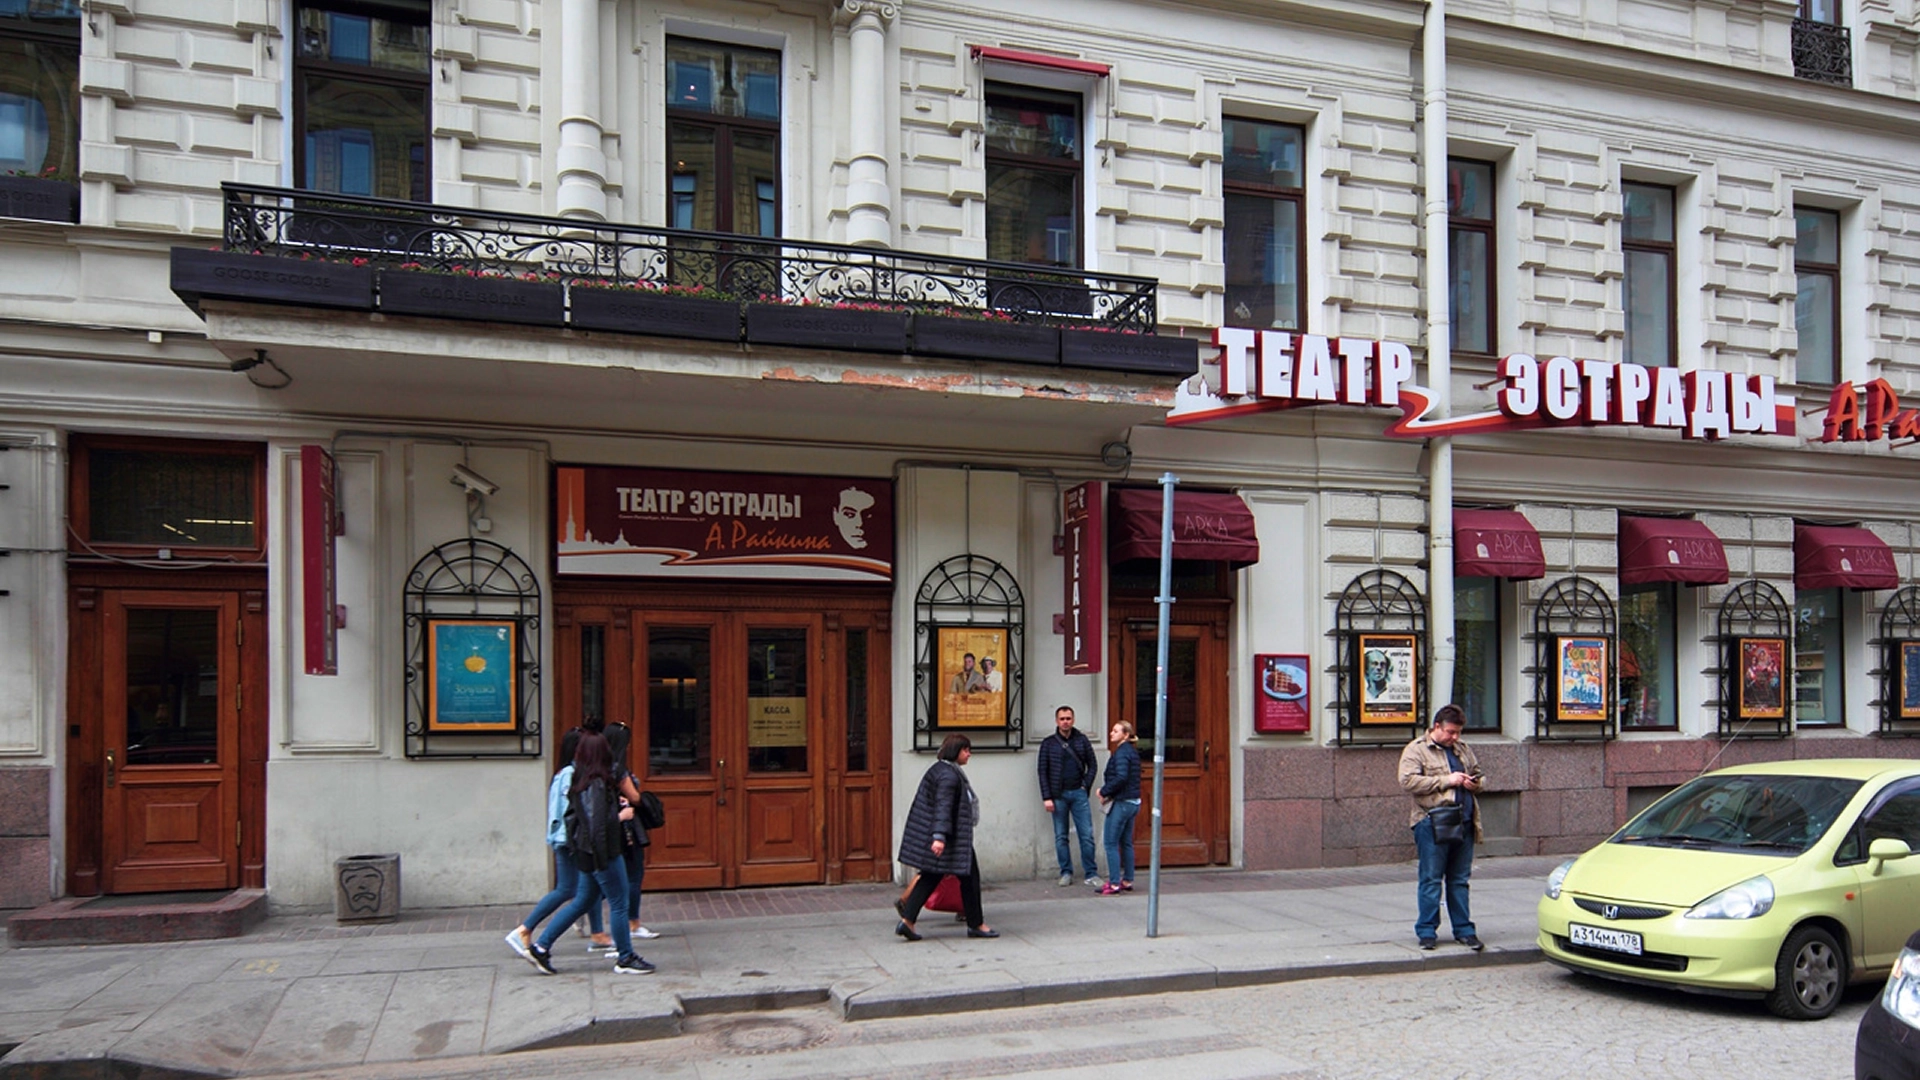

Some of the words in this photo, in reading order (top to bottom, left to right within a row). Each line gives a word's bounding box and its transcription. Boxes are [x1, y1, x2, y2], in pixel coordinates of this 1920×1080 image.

[212, 266, 270, 283] GOOSE
[275, 273, 333, 291] GOOSE
[419, 286, 471, 303] GOOSE
[477, 292, 527, 308] GOOSE
[608, 304, 656, 319] GOOSE
[660, 309, 707, 324] GOOSE
[783, 318, 827, 332] GOOSE
[831, 322, 874, 334] GOOSE
[1212, 327, 1413, 406] ТЕАТР
[1499, 354, 1776, 441] ЭСТРАДЫ
[616, 487, 686, 515] ТЕАТР
[690, 490, 802, 520] ЭСТРАДЫ
[705, 521, 726, 551] А.
[732, 520, 833, 550] Райкина
[1183, 515, 1229, 537] АРКА
[1494, 533, 1536, 554] АРКА
[1684, 540, 1720, 560] АРКА
[1072, 526, 1081, 661] ТЕАТР
[763, 706, 791, 715] КАССА
[1574, 927, 1617, 946] А314МА
[1620, 934, 1639, 946] 178
